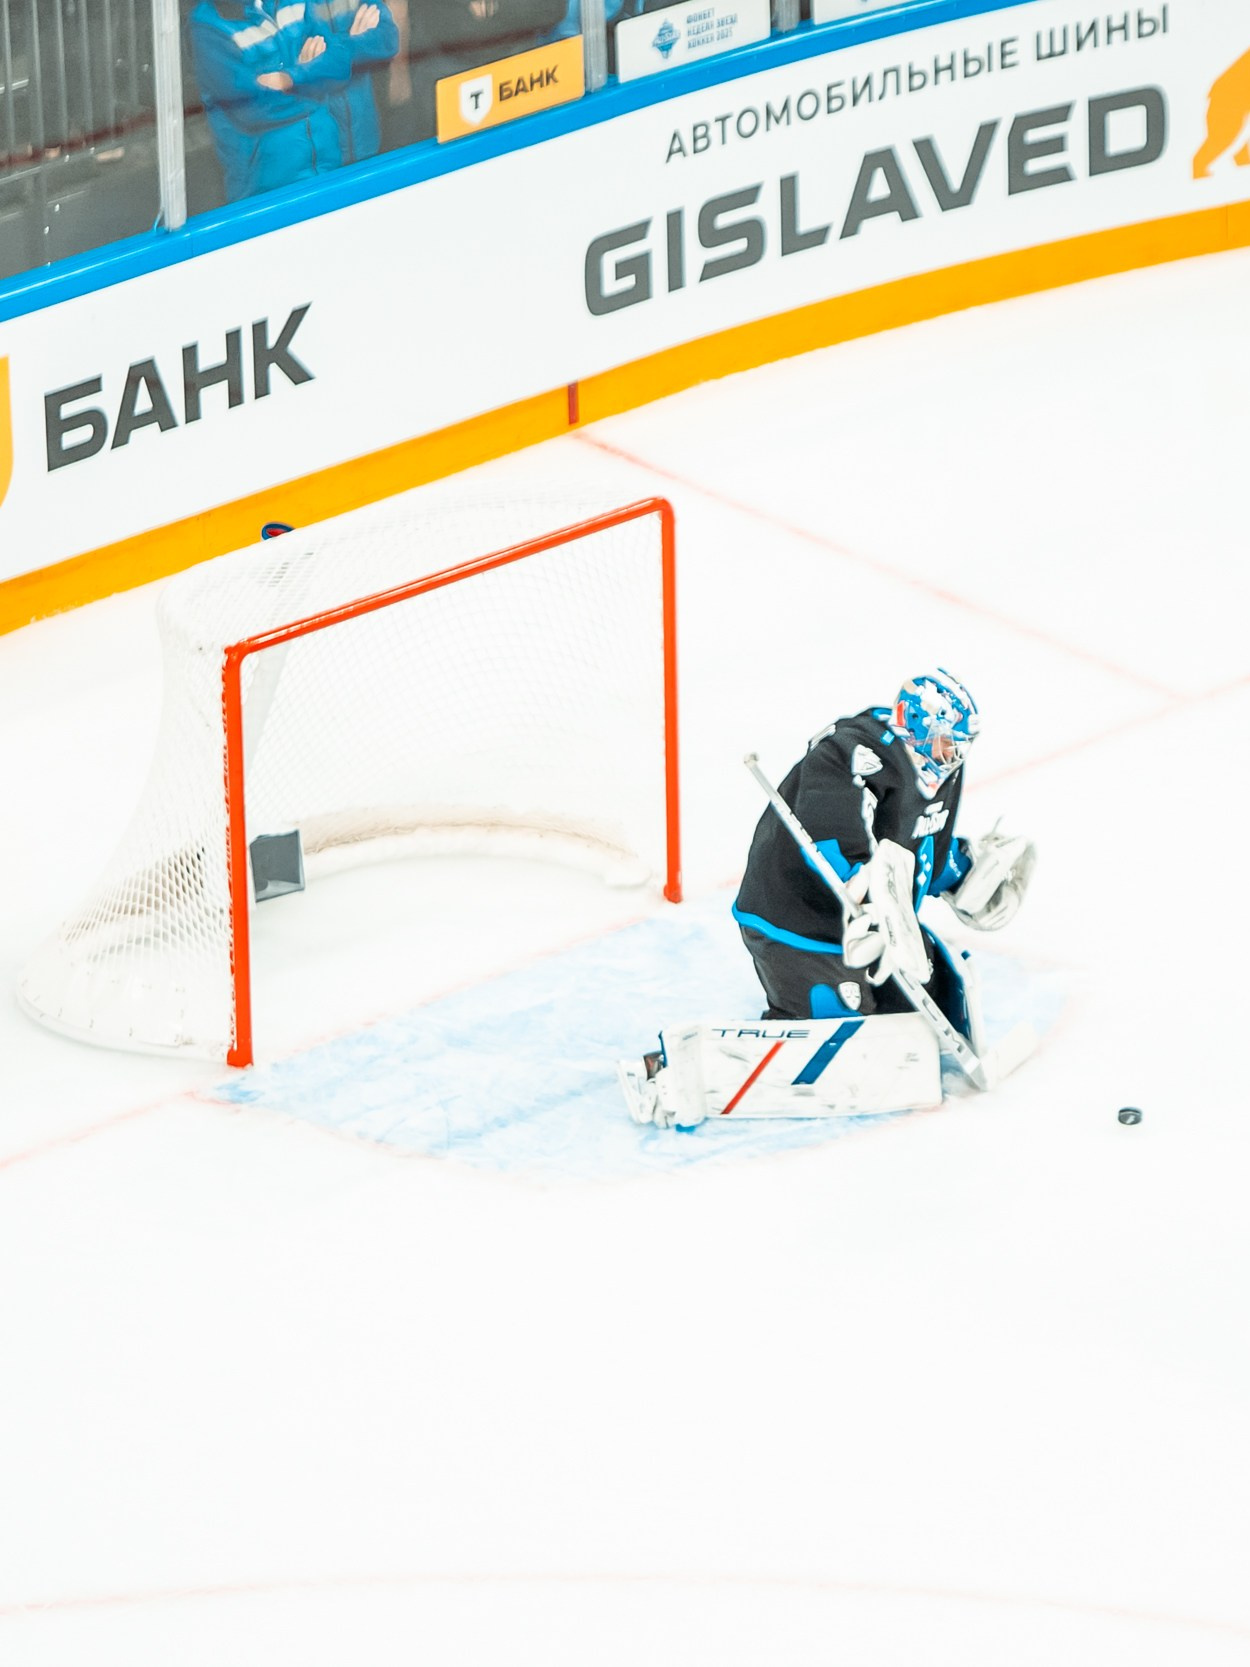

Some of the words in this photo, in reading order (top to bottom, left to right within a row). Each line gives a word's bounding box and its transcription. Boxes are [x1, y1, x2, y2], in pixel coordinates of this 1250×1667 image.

[498, 65, 559, 102] БАНК
[665, 37, 1019, 164] АВТОМОБИЛЬНЫЕ
[1035, 4, 1169, 62] ШИНЫ
[584, 85, 1169, 317] GISLAVED
[43, 302, 316, 473] БАНК
[712, 1028, 810, 1039] TRUE
